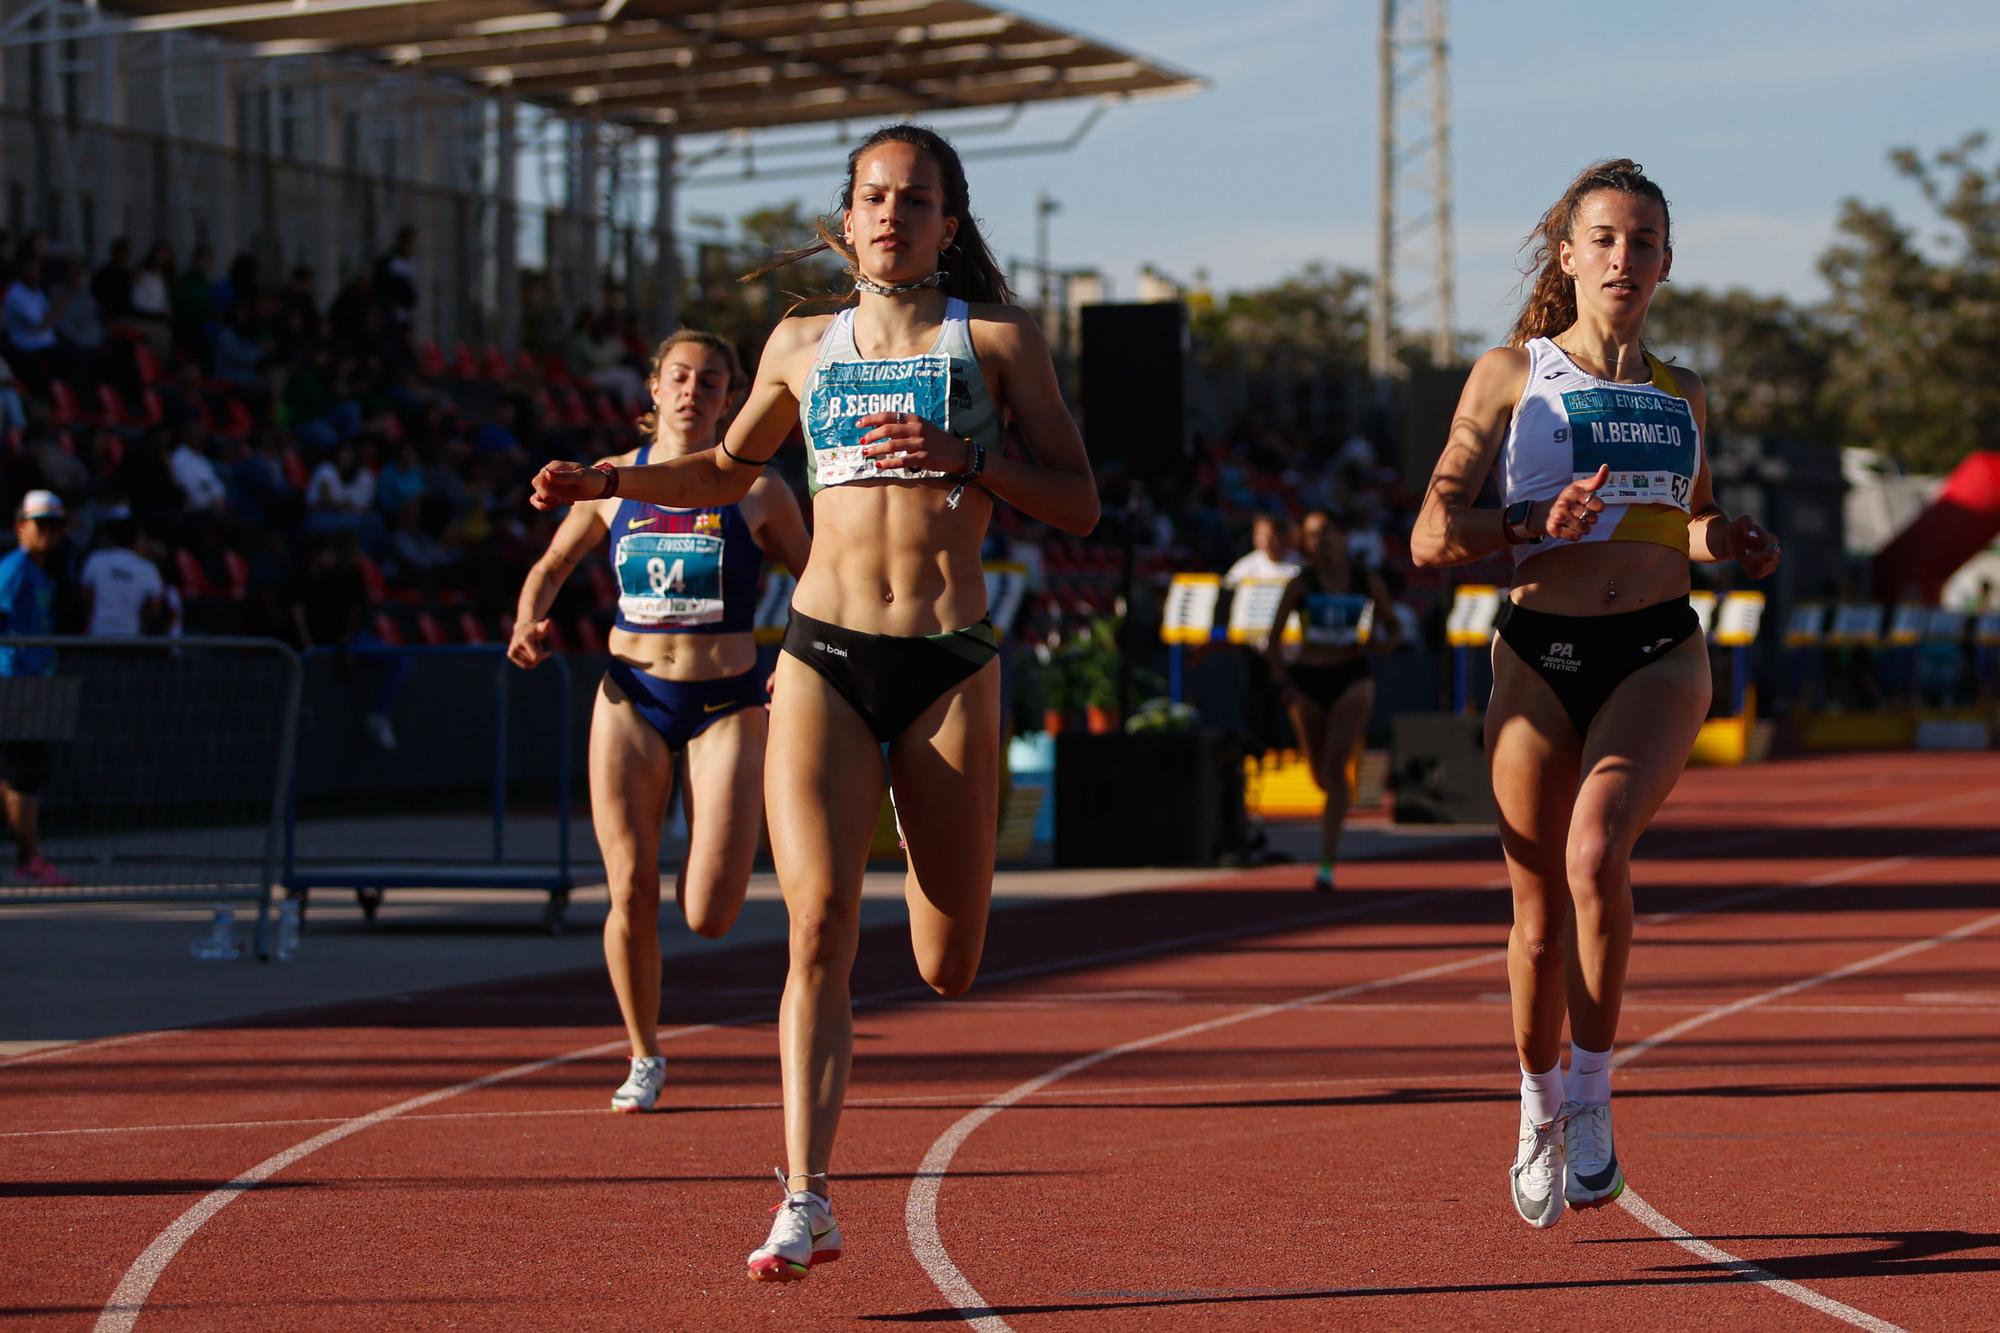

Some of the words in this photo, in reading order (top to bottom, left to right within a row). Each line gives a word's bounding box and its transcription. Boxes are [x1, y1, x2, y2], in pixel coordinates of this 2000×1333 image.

[860, 362, 914, 382] EIVISSA
[829, 392, 916, 418] B.SEGURA
[1615, 393, 1663, 412] EIVISSA
[1591, 421, 1682, 447] N.BERMEJO
[1671, 474, 1691, 508] 52
[646, 557, 686, 594] 84
[1540, 655, 1582, 667] PAMPLONA
[1550, 642, 1574, 658] PA
